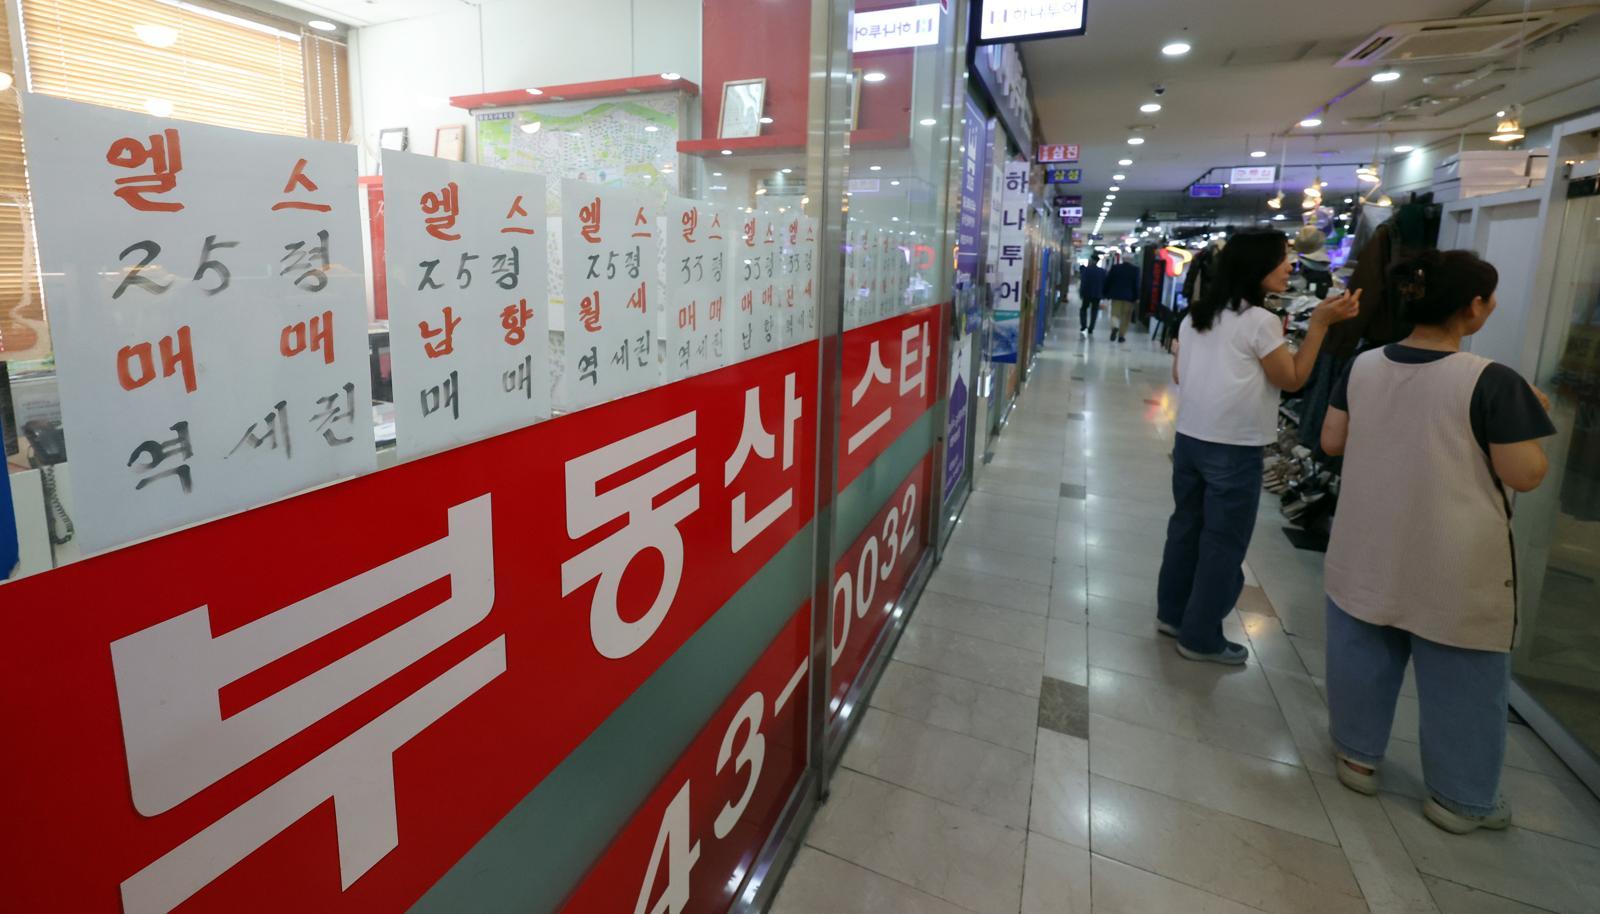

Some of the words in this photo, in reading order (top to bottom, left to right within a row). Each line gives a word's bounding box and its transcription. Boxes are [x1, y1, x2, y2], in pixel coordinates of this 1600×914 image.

[106, 128, 332, 212] 엘스
[420, 182, 534, 240] 엘스
[579, 197, 651, 243] 엘스
[682, 206, 722, 243] 엘스
[1000, 170, 1029, 303] 하나투어
[111, 230, 330, 300] 25평
[418, 299, 534, 358] 남향
[579, 281, 646, 332] 월세
[679, 296, 722, 331] 매매
[741, 285, 773, 315] 매매
[116, 311, 335, 394] 매매
[420, 355, 531, 420] 매매
[110, 372, 802, 914] 부동산
[848, 321, 930, 455] 스타
